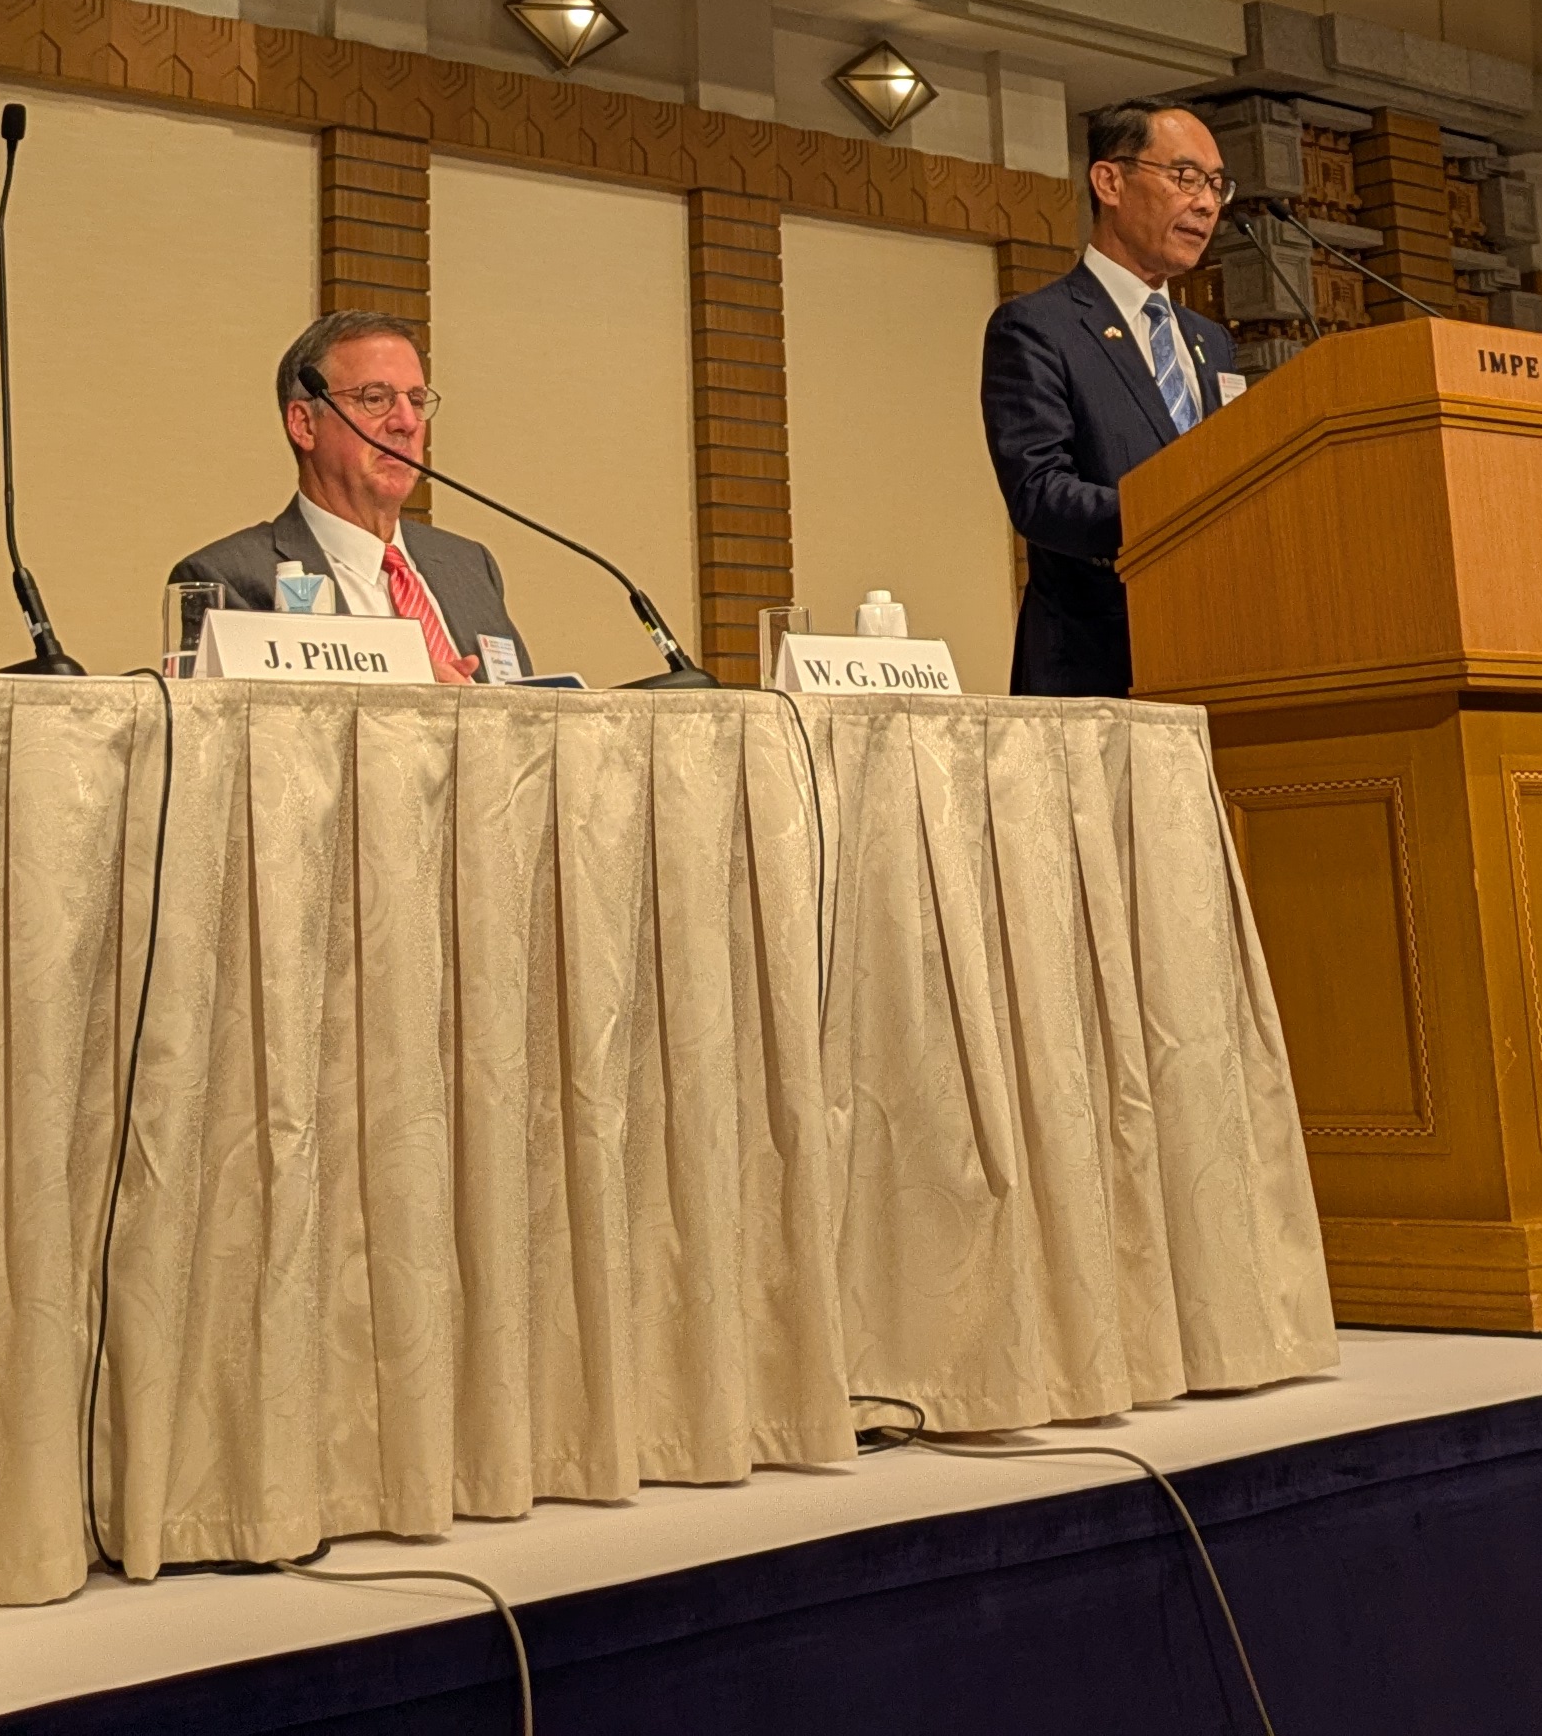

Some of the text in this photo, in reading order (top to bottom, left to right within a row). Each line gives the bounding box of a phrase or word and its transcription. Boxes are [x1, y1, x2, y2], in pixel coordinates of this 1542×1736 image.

[264, 640, 389, 673] J. Pillen
[803, 659, 950, 690] W. G. Dobie
